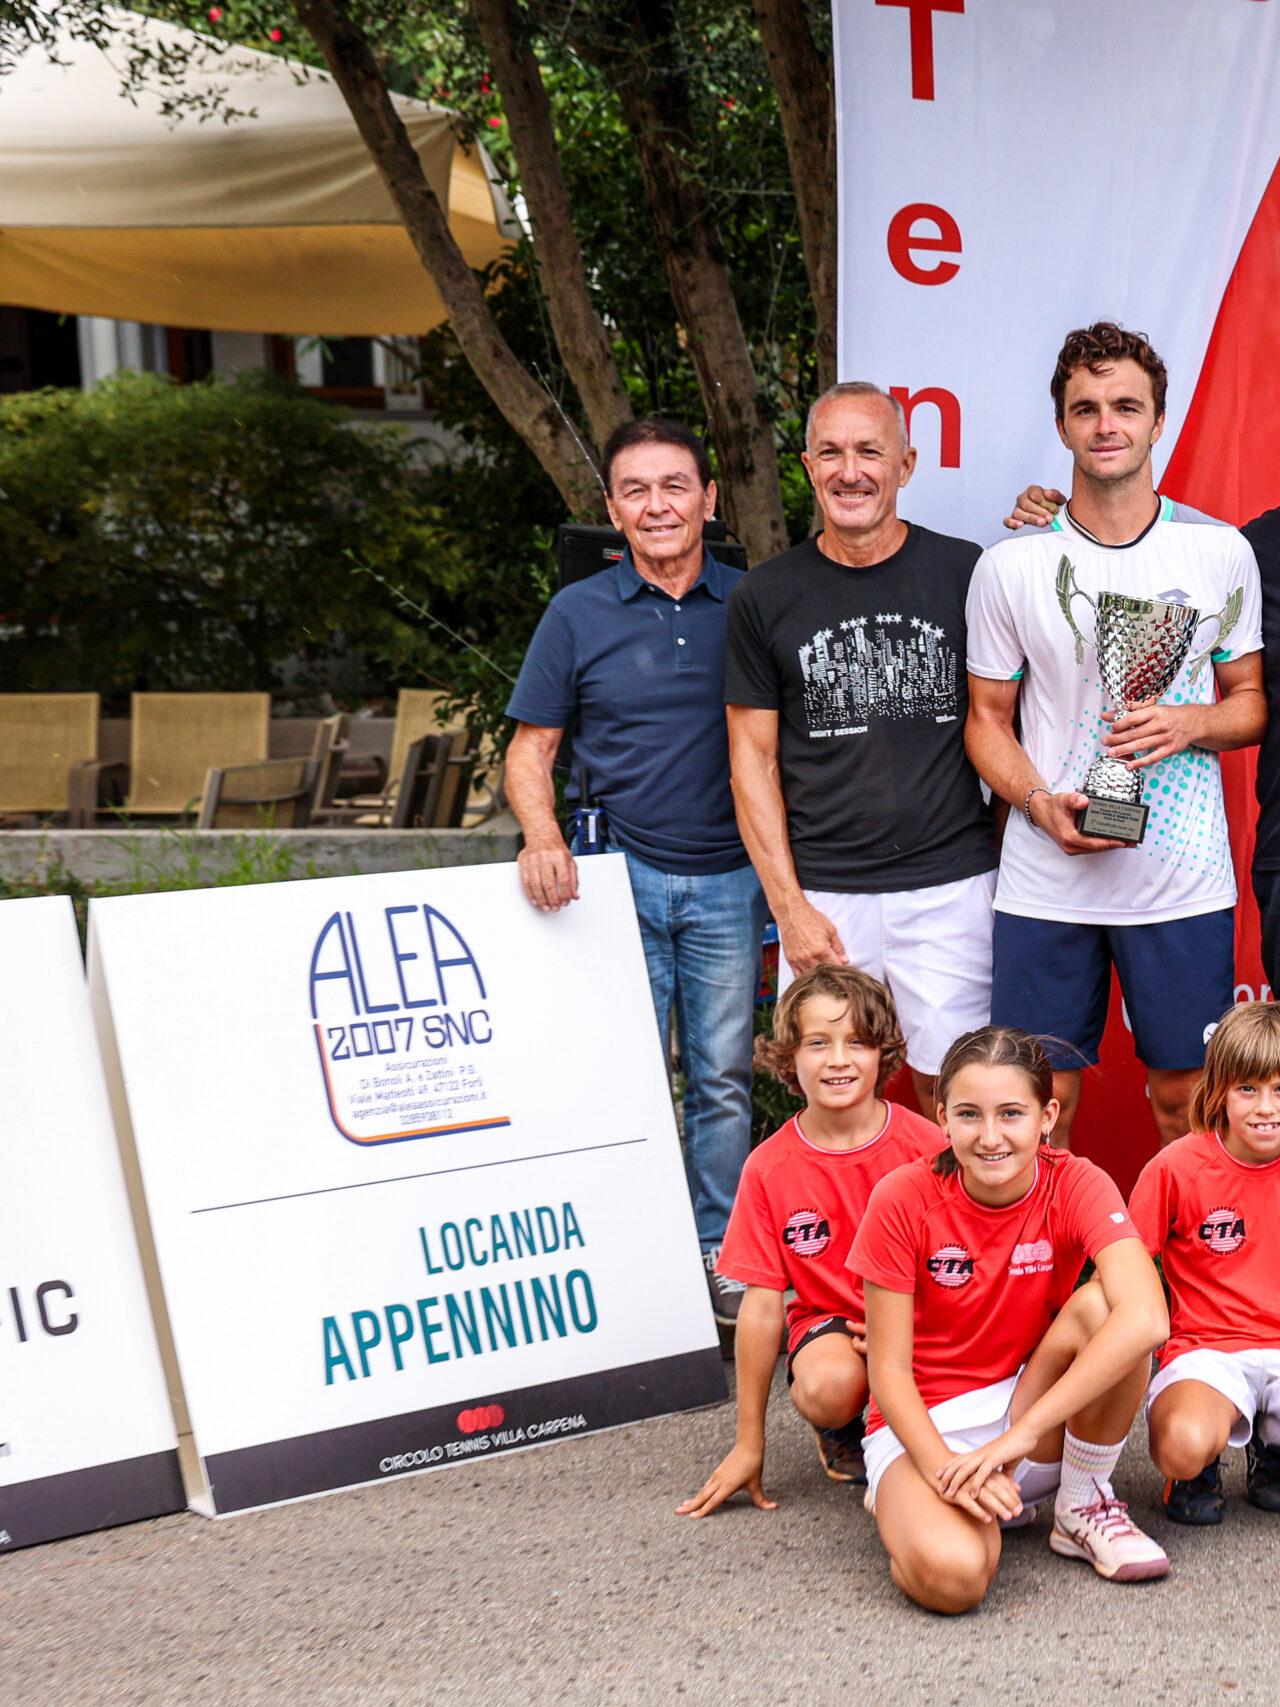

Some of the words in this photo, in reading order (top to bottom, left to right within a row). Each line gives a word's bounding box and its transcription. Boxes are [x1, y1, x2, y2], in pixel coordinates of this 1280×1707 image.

[834, 725, 868, 737] SESSION
[309, 903, 487, 1019] ALEA
[327, 1017, 414, 1060] 2007
[423, 1009, 492, 1049] SNC
[419, 1202, 586, 1275] LOCANDA
[783, 1219, 830, 1245] CTA
[1198, 1219, 1246, 1240] CTA
[926, 1258, 974, 1275] CTA
[0, 1280, 78, 1343] IC
[321, 1269, 599, 1386] APPENNINO
[379, 1445, 443, 1473] CIRCOLO
[443, 1433, 490, 1459] TENNIS
[490, 1427, 526, 1447] VILLA
[526, 1413, 587, 1440] CARPENA
